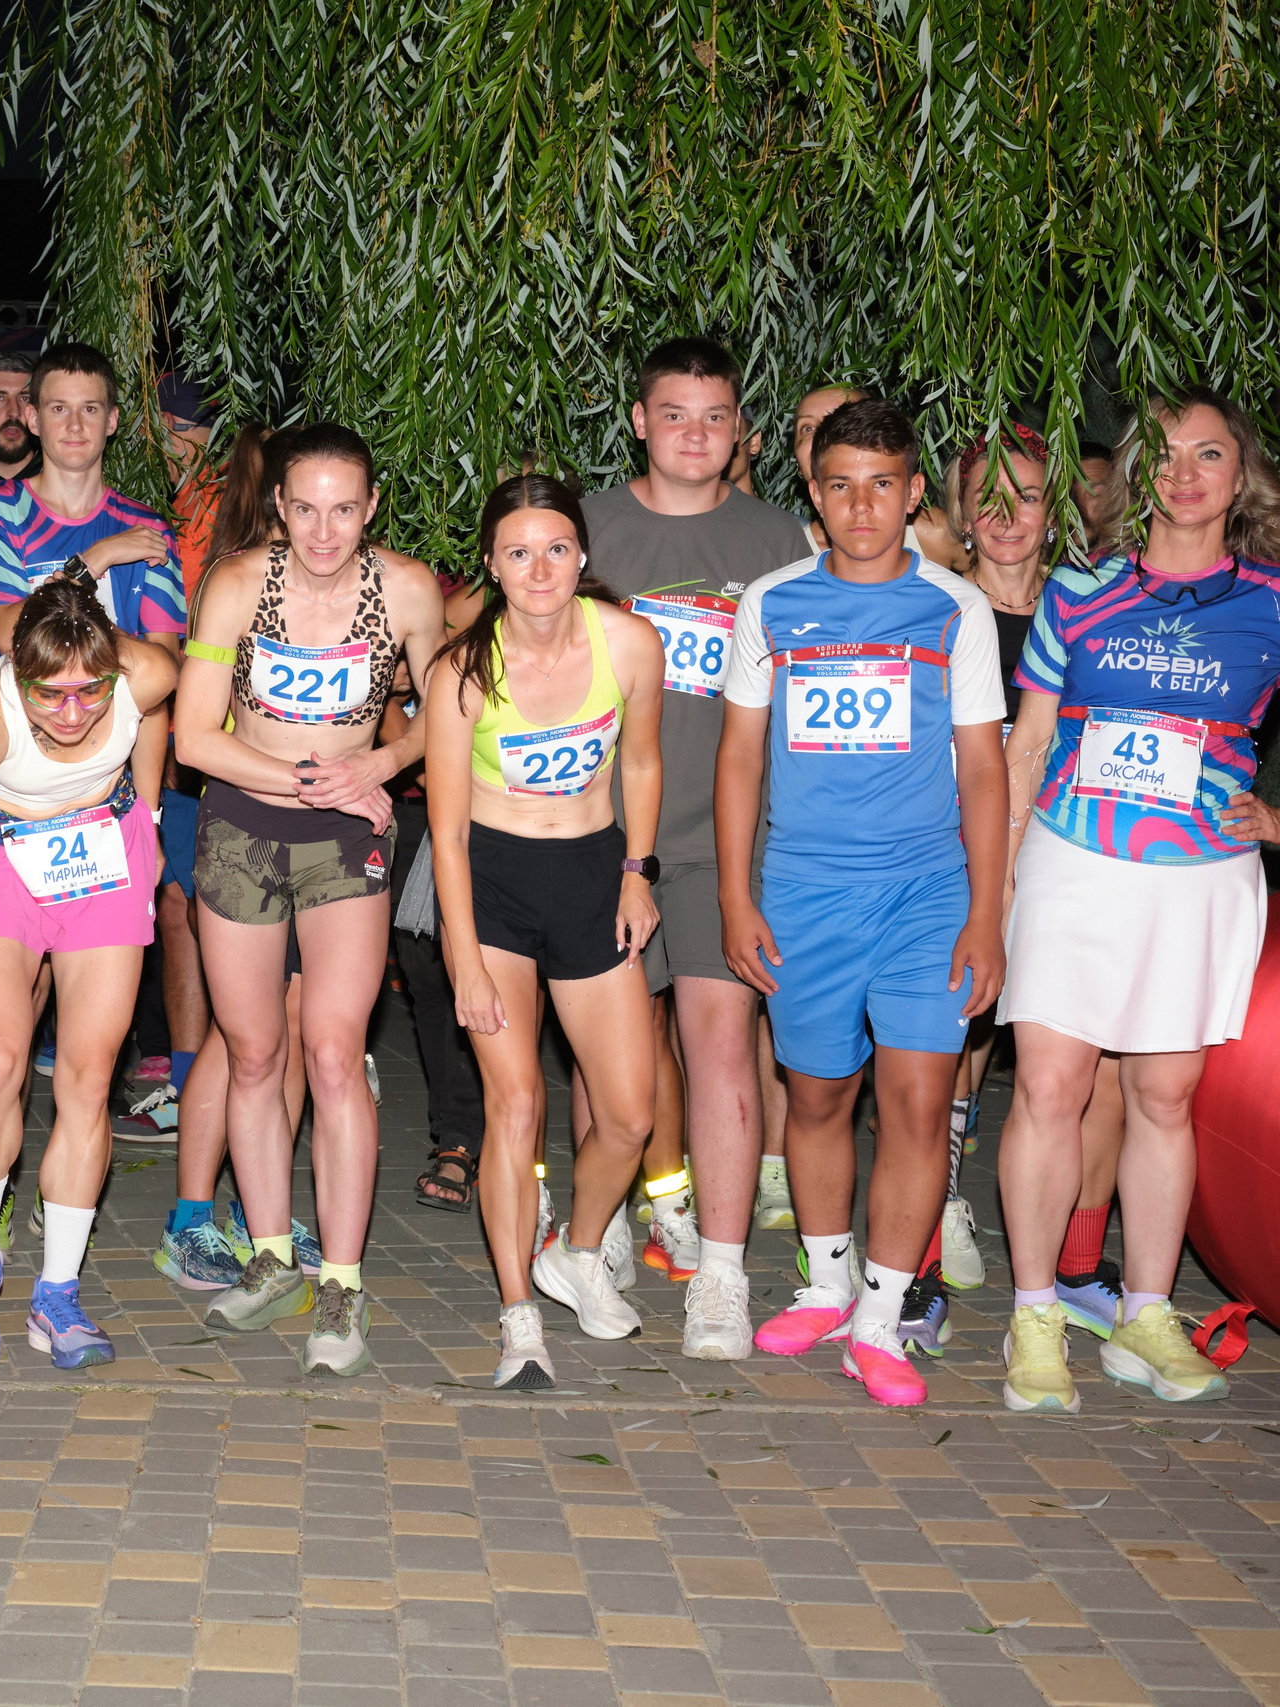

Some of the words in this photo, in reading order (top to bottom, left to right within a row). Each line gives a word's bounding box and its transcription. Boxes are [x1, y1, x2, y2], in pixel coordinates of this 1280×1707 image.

[725, 581, 745, 592] NIKE
[816, 643, 863, 652] ВОЛГОГРАД
[820, 649, 860, 657] МАРАФОН
[1106, 637, 1165, 653] НОЧЬ
[1096, 652, 1222, 678] ЛЮБВИ
[268, 664, 349, 703] 221
[1150, 673, 1163, 689] К
[1170, 676, 1219, 694] БЕГУ
[805, 687, 892, 730] 289
[1129, 713, 1158, 721] ЛЮБВИ
[1112, 717, 1151, 726] VOLGOGRAD
[1153, 723, 1176, 731] ARENA
[1112, 731, 1160, 766] 43
[523, 738, 604, 785] 223
[1100, 762, 1165, 786] ОКСАНА
[47, 831, 88, 867] 24
[43, 861, 98, 884] МАРИНА
